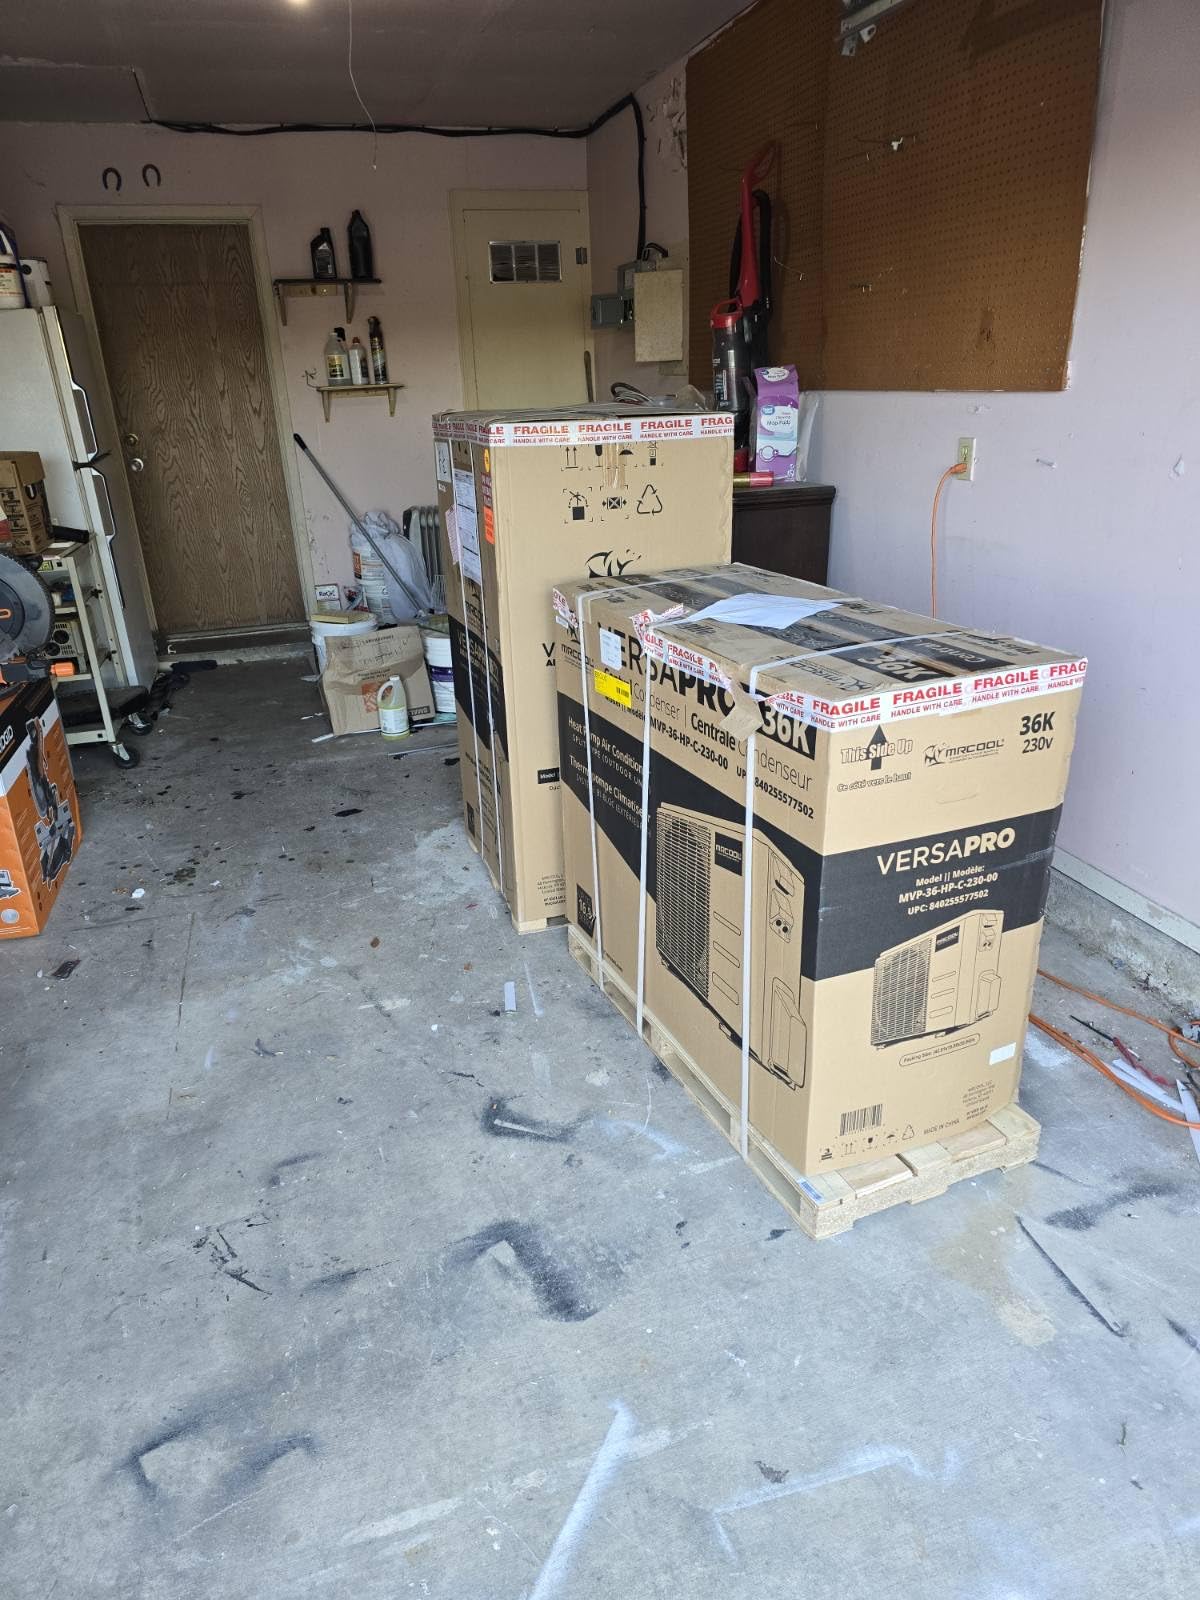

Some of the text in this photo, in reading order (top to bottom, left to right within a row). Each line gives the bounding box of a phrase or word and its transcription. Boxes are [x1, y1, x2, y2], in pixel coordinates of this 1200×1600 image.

[513, 425, 569, 434] FRAGILE
[578, 422, 632, 433] FRAGILE
[641, 419, 693, 430] FRAGILE
[701, 416, 733, 427] FRAG
[668, 643, 703, 666] FRAGILE
[1049, 661, 1087, 677] FRAG
[973, 669, 1039, 690] FRAGILE
[1047, 680, 1073, 689] HANDLE
[893, 682, 963, 705] FRAGILE
[971, 685, 1039, 703] HANDLE WITH CARE
[789, 706, 804, 718] CARE
[812, 697, 880, 716] FRAGILE
[891, 698, 963, 718] HANDLE WITH CARE
[810, 714, 881, 729] HANDLE WITH CARE
[1019, 711, 1056, 736] 36K
[568, 715, 583, 735] Heat
[601, 737, 611, 753] Air
[612, 744, 643, 774] Condition
[690, 712, 813, 792] Centrale Cndenseur
[841, 738, 914, 764] This Side Up
[945, 740, 1003, 758] MRCOOL
[736, 764, 747, 780] UP
[754, 776, 815, 820] 840255577502
[877, 827, 1016, 876] VERSAPRO
[915, 873, 943, 887] Model
[952, 865, 985, 879] Modèle:
[898, 872, 999, 904] MVP-36-HP-C-230-00
[907, 889, 989, 915] UPC: 840255577502
